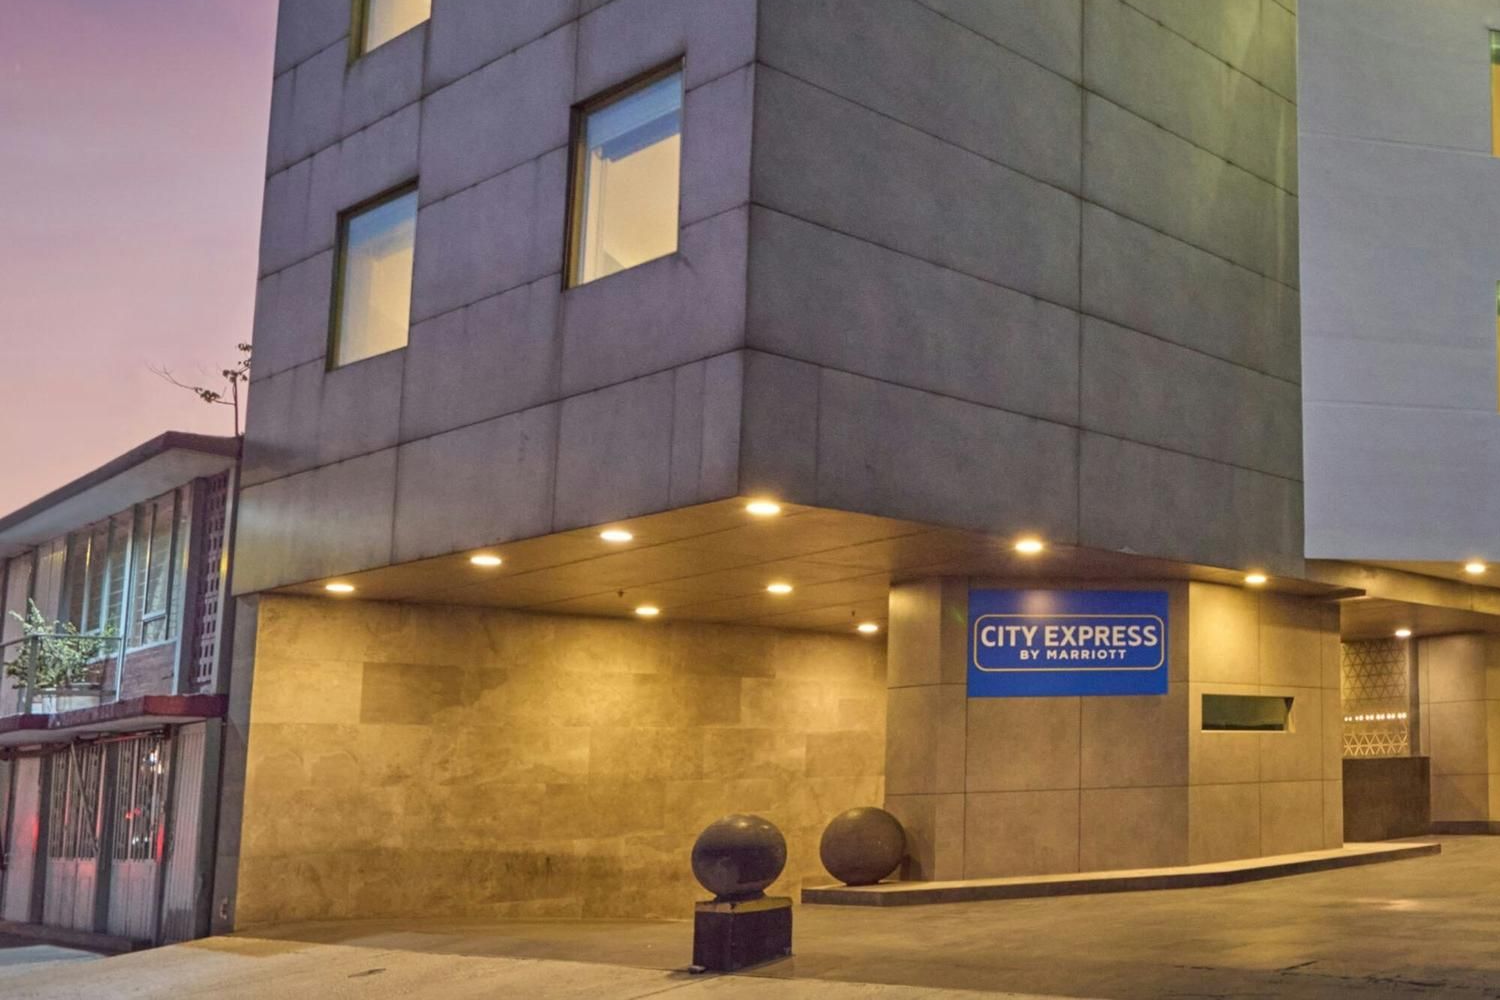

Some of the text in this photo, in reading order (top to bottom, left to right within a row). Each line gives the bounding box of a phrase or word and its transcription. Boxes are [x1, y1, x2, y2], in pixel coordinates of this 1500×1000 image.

[981, 625, 1158, 647] CITY EXPRESS
[1019, 649, 1127, 660] BY MARRIOTT
